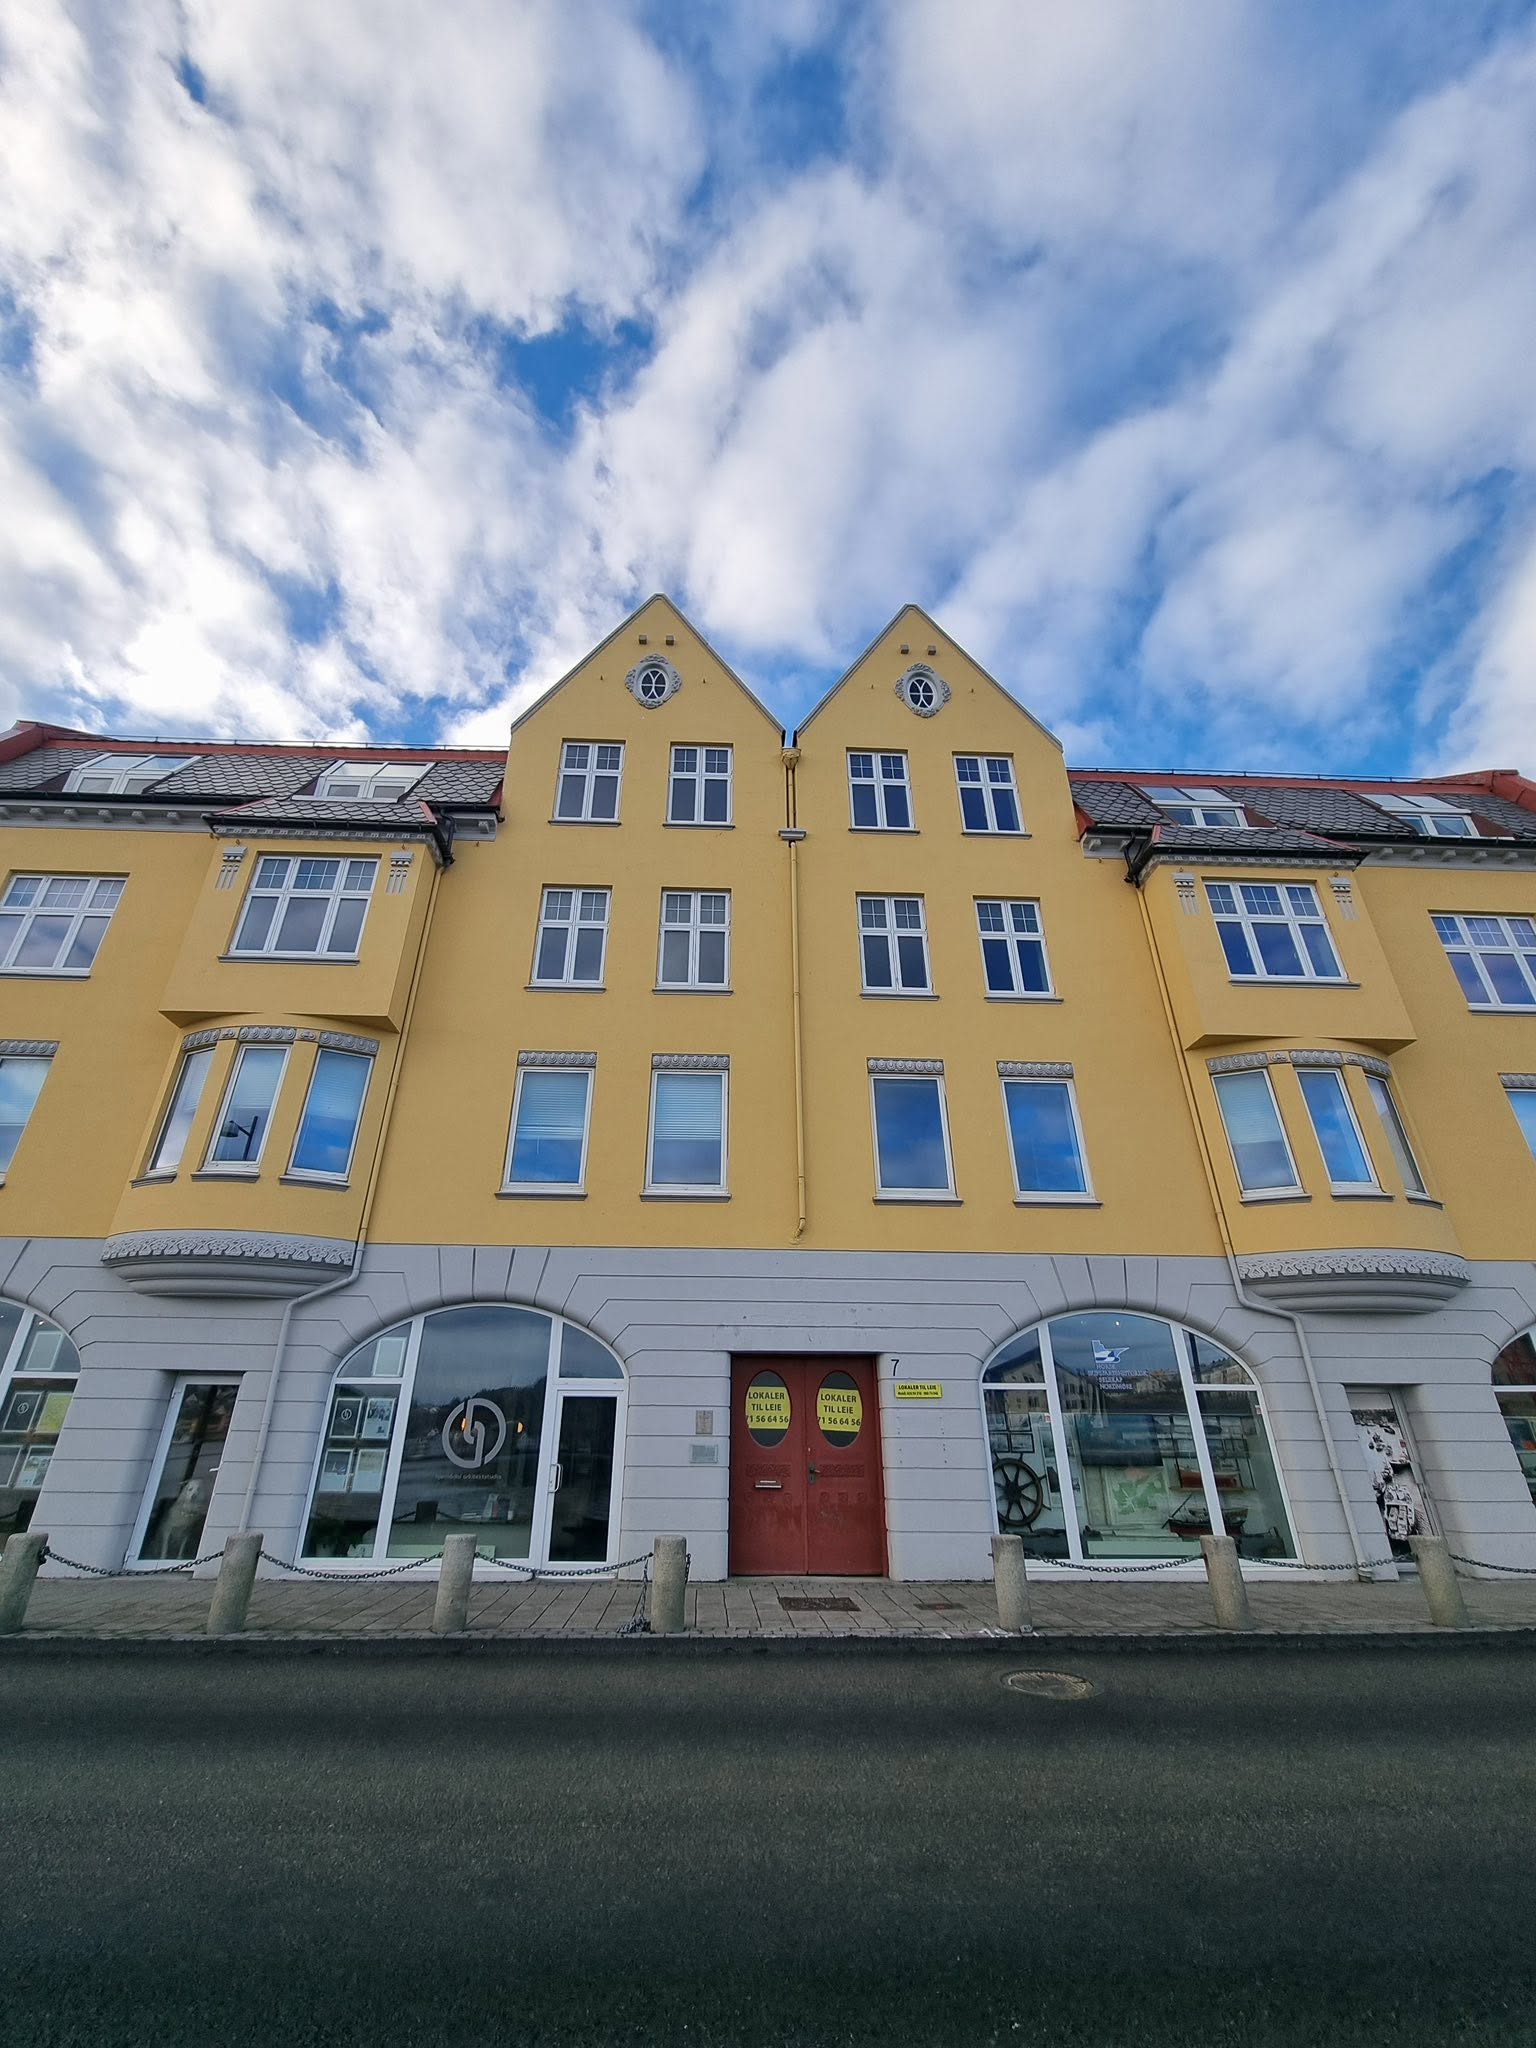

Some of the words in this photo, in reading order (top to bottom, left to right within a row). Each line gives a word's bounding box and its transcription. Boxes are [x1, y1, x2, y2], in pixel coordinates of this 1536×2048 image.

[891, 1359, 899, 1376] 7
[748, 1391, 785, 1400] LOKALER
[820, 1393, 857, 1403] LOKALER
[751, 1403, 763, 1411] TIL
[765, 1403, 782, 1411] LEIE
[823, 1404, 836, 1413] TIL
[837, 1406, 854, 1414] LEIE
[779, 1415, 789, 1423] 56
[828, 1417, 838, 1425] 56
[840, 1417, 849, 1426] 64
[851, 1418, 861, 1427] 56
